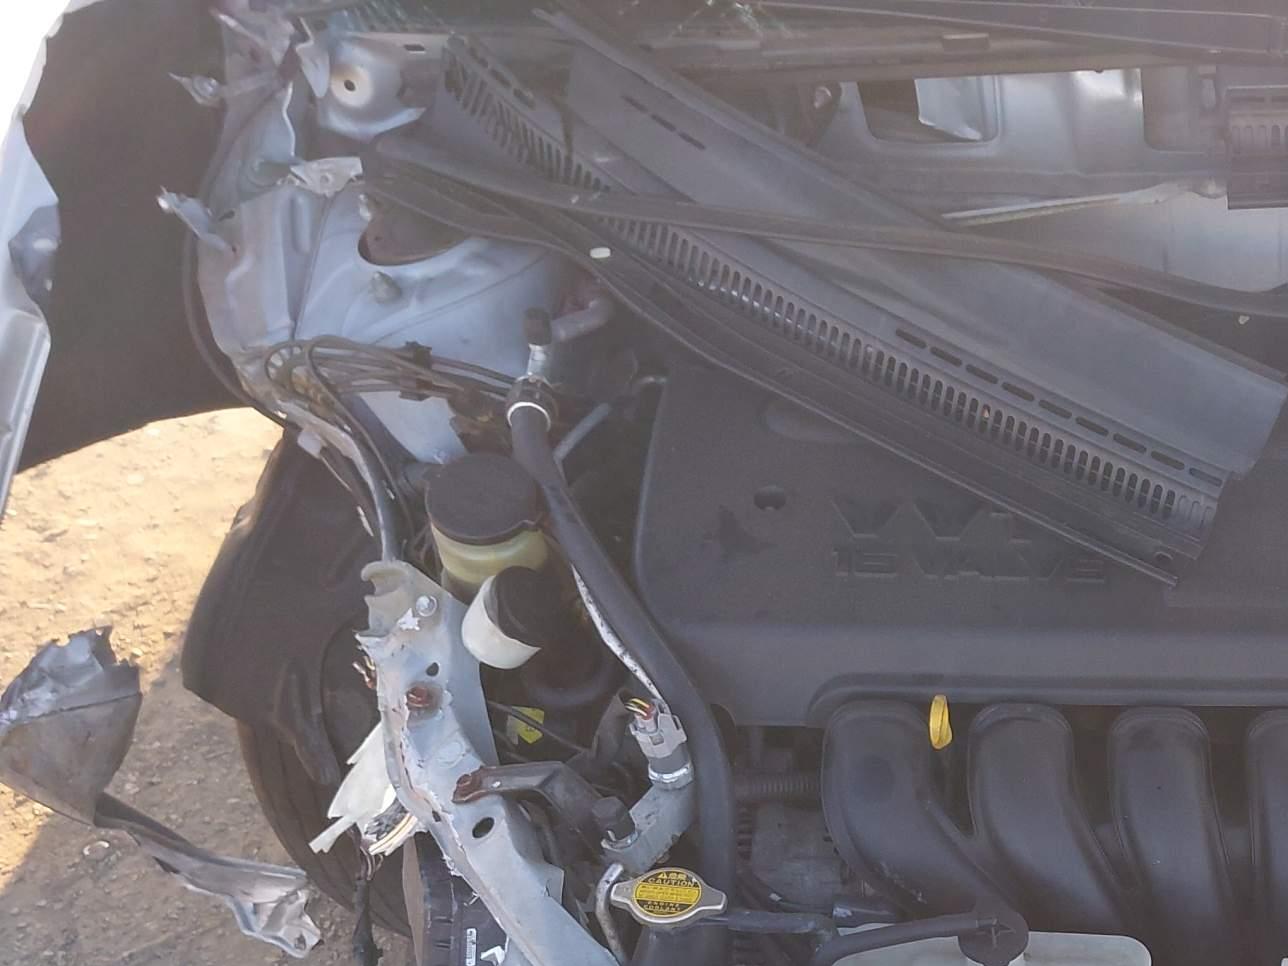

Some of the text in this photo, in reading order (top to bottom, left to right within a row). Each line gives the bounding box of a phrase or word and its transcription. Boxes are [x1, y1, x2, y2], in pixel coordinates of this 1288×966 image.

[911, 549, 1106, 583] VALVE
[647, 877, 694, 887] CAUTION
[643, 904, 681, 913] COOLANT
